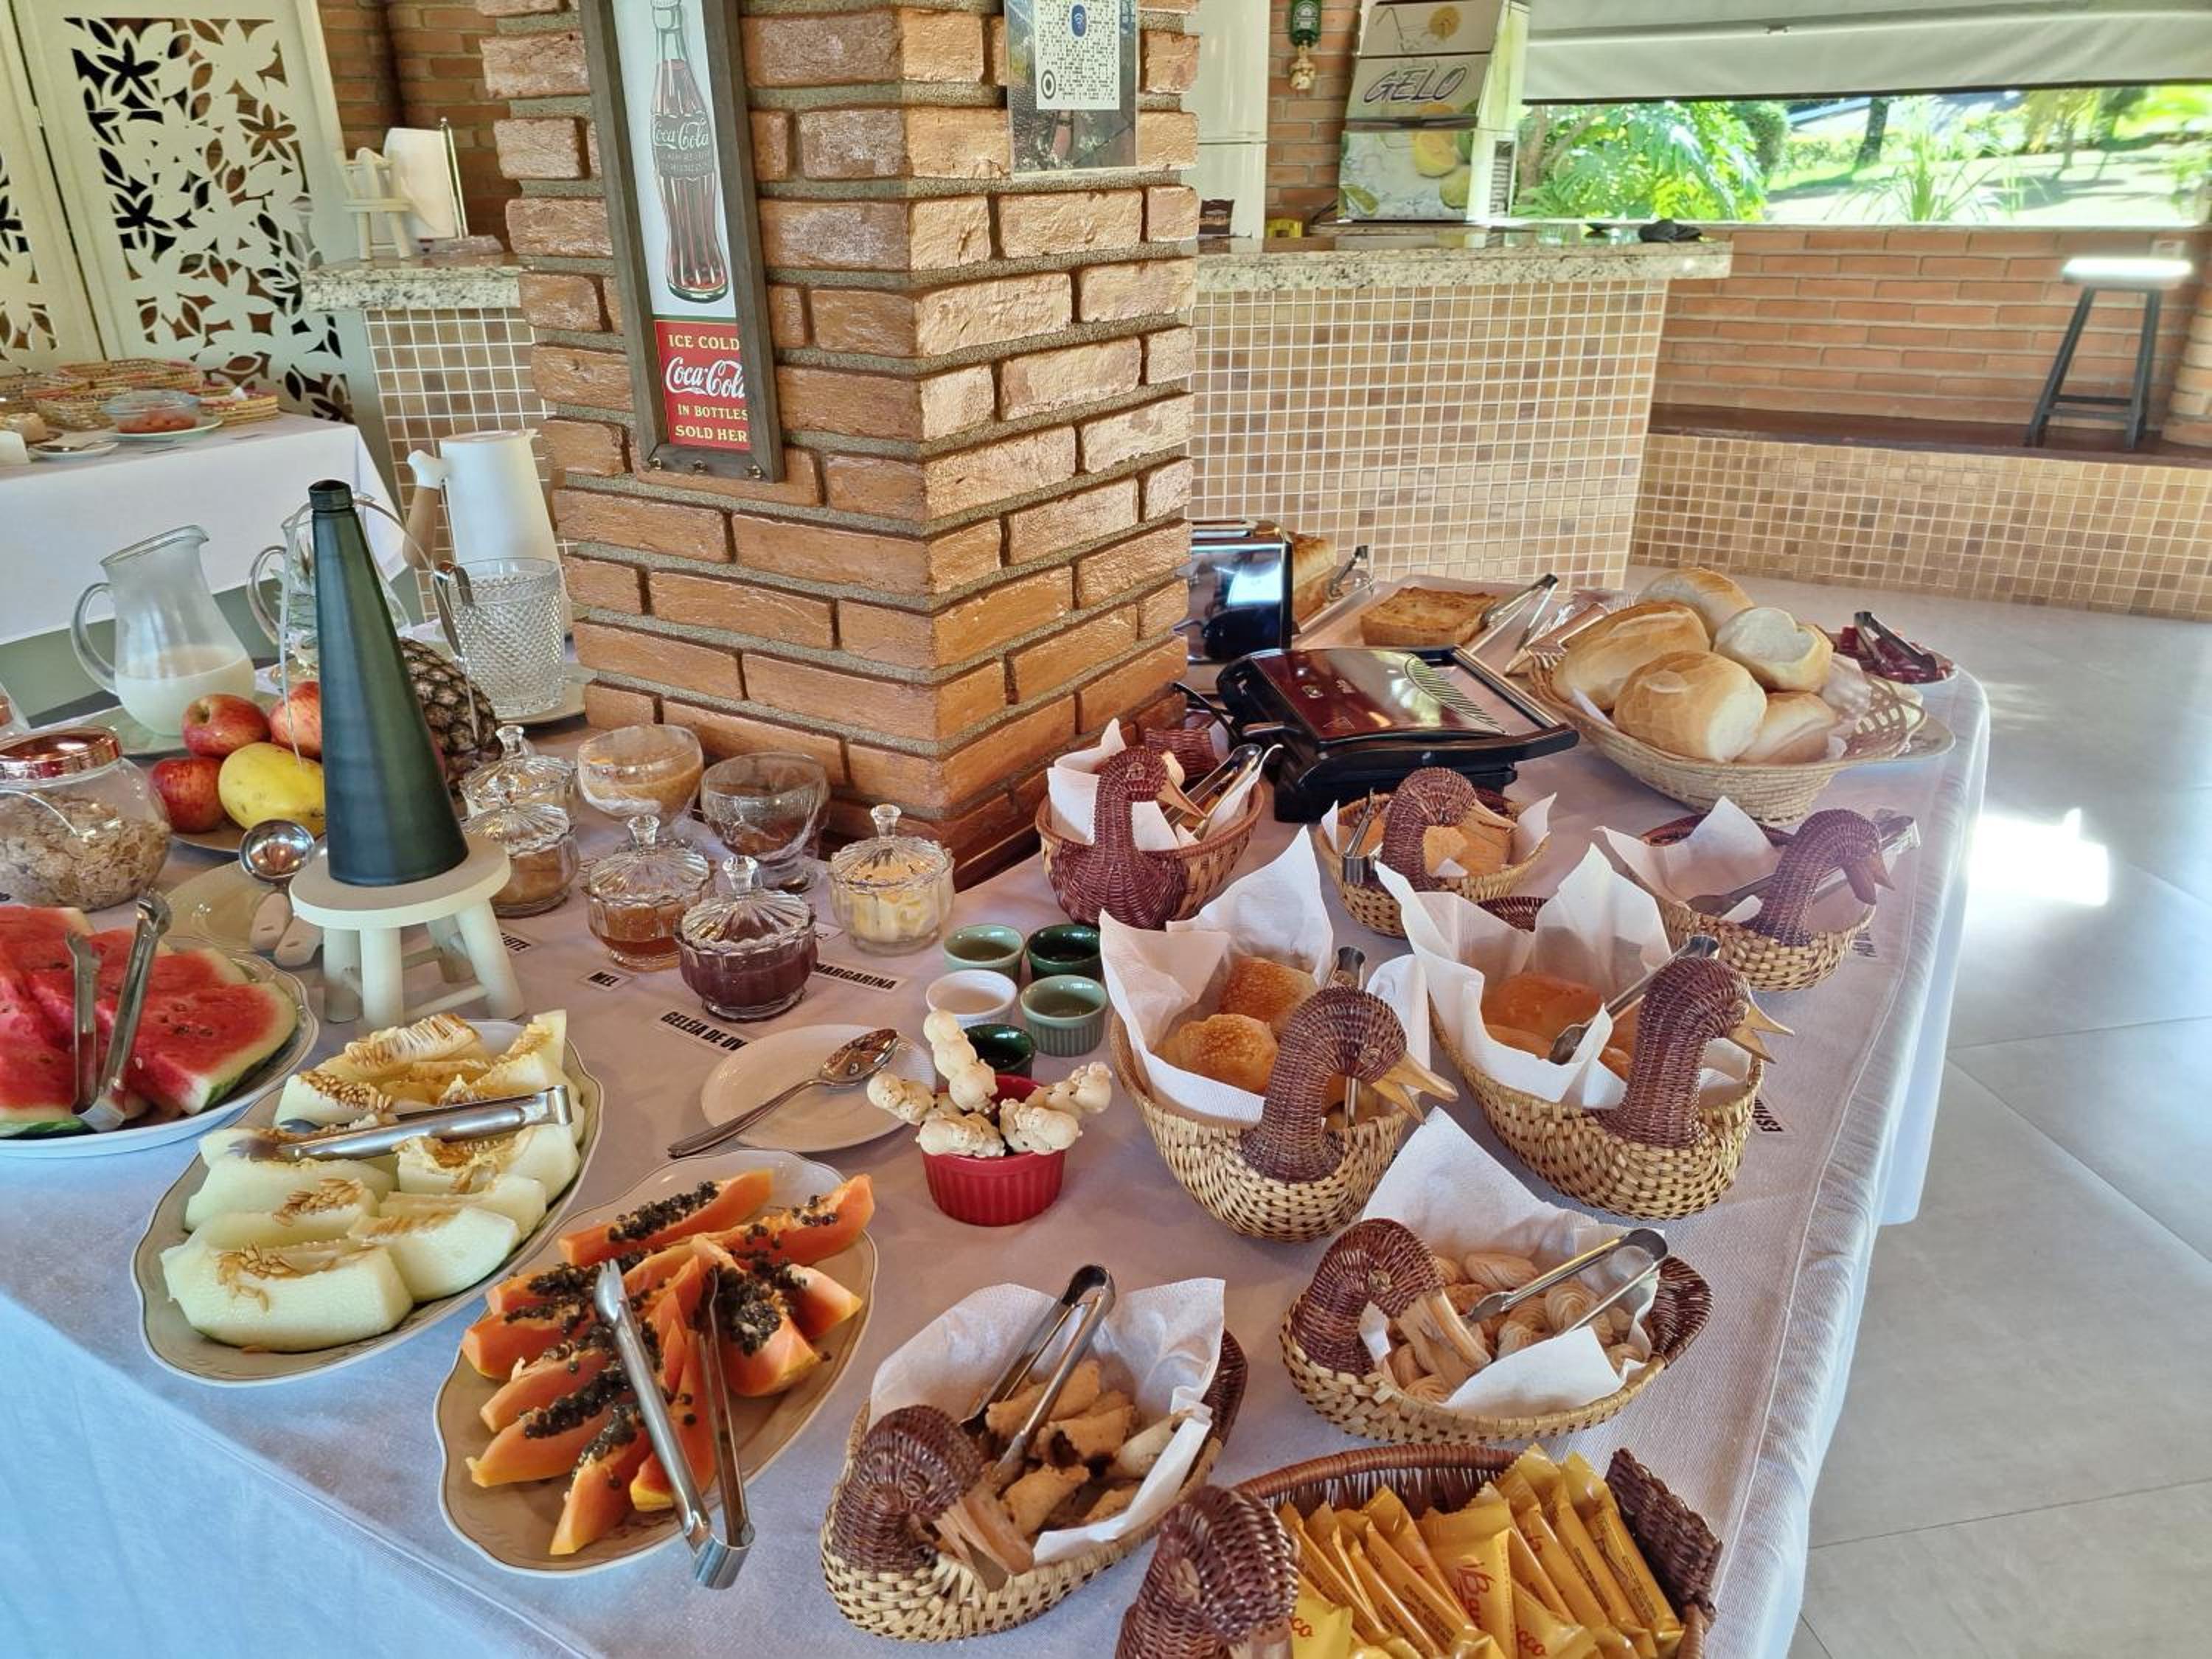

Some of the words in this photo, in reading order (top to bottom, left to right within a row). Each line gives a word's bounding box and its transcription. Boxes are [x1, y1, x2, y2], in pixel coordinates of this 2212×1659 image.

[1364, 66, 1468, 103] GELO
[668, 334, 694, 348] ICE
[698, 335, 740, 350] COLD
[678, 403, 689, 416] IN
[695, 406, 748, 421] BOTTLES
[675, 425, 714, 439] SOLD
[717, 428, 748, 442] HER
[588, 971, 620, 987] MEL
[701, 1029, 728, 1043] DE
[720, 1036, 749, 1051] UV
